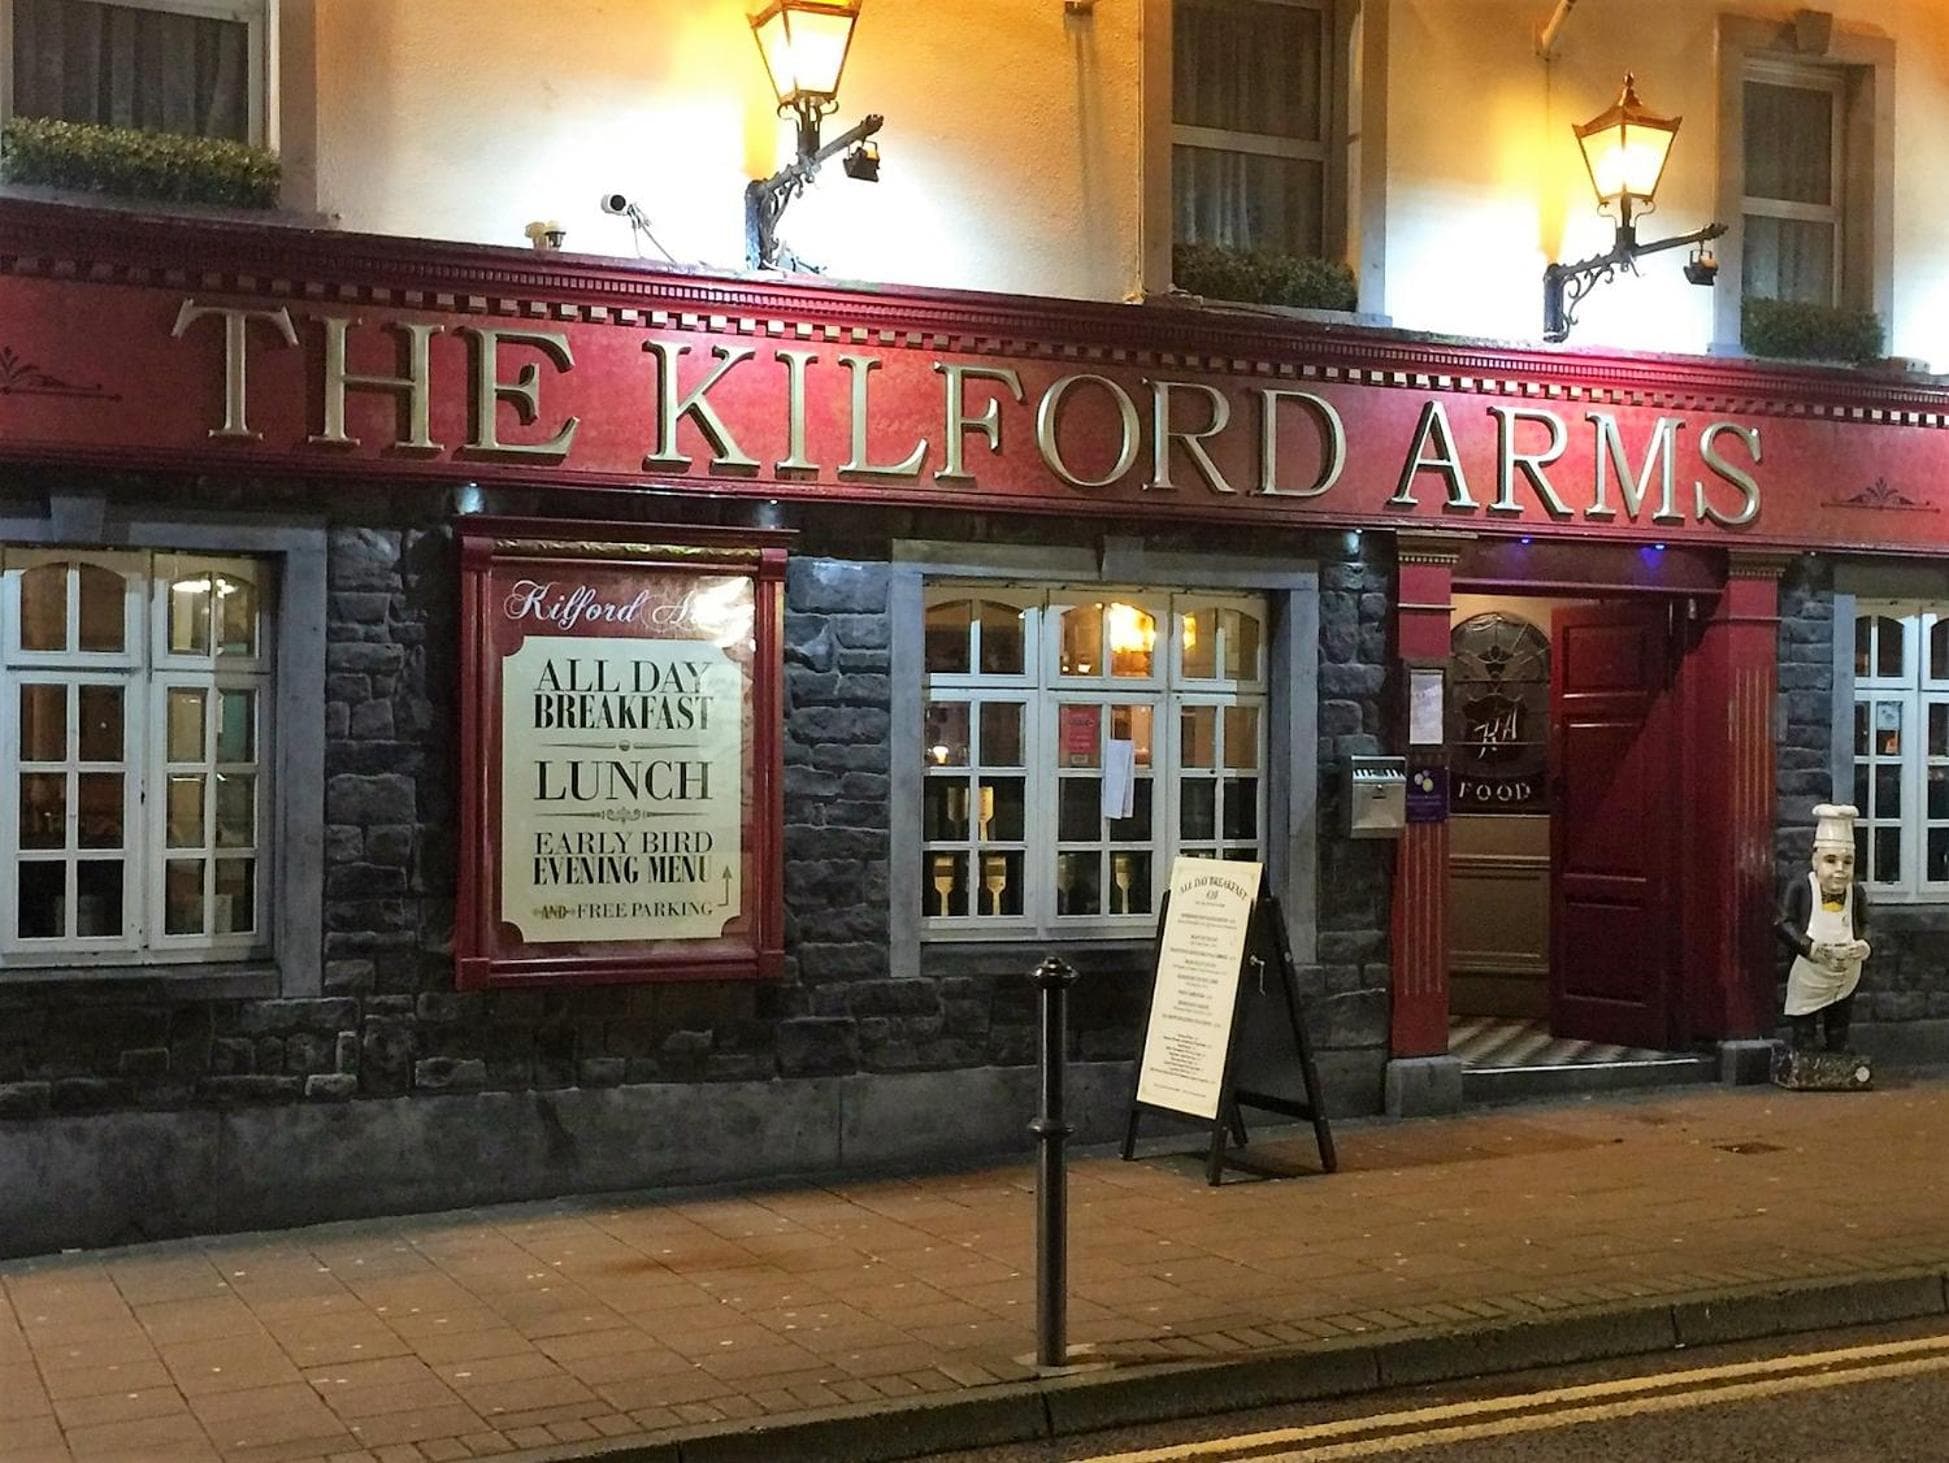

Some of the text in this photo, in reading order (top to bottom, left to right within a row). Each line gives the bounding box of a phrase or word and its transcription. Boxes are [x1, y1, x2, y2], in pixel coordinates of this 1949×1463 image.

[171, 298, 1762, 526] THE KILFORD ARMS
[503, 580, 650, 631] Kilford
[534, 658, 713, 694] ALL DAY
[534, 693, 714, 730] BREAKFAST
[534, 760, 713, 801] LUNCH
[1458, 782, 1531, 801] FOOD
[534, 831, 713, 855] EARLY BIRD
[533, 855, 712, 886] EVENING MENU
[540, 901, 713, 920] AND FREE PARKING
